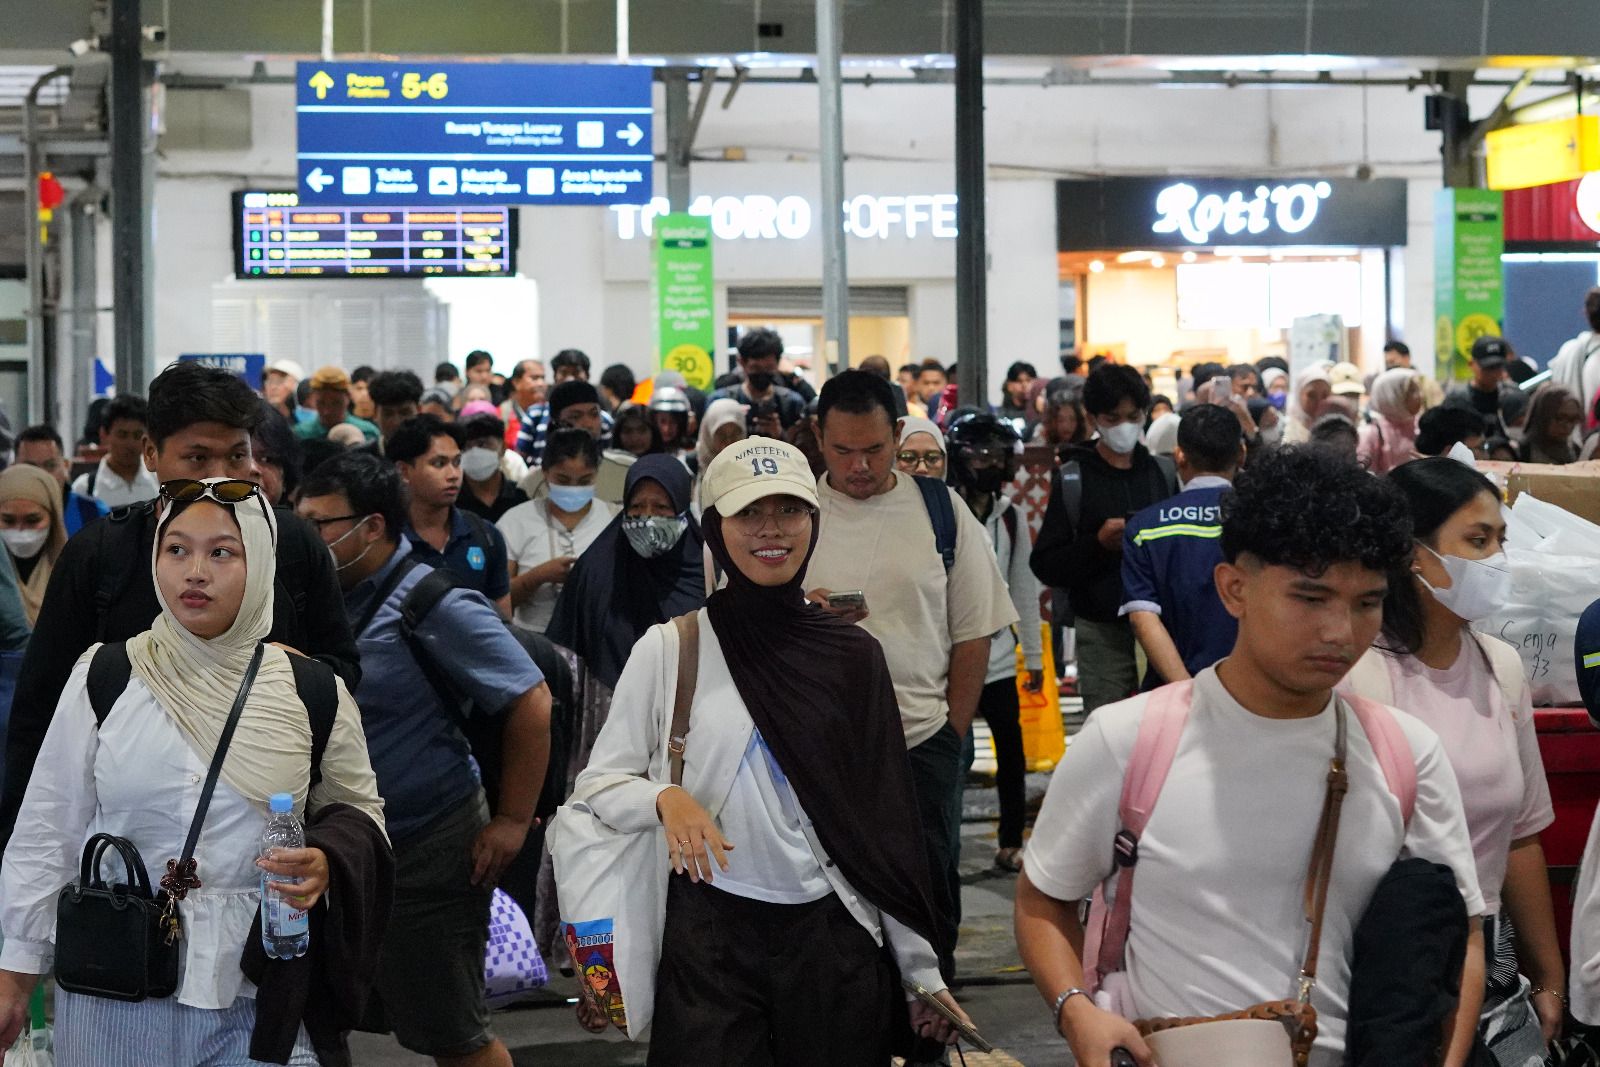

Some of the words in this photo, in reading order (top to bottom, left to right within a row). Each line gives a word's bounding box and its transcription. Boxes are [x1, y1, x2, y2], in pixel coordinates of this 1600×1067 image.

[375, 168, 413, 182] Toilet
[843, 194, 958, 238] OFFE
[736, 446, 790, 461] NINETEEN
[751, 457, 779, 476] 19
